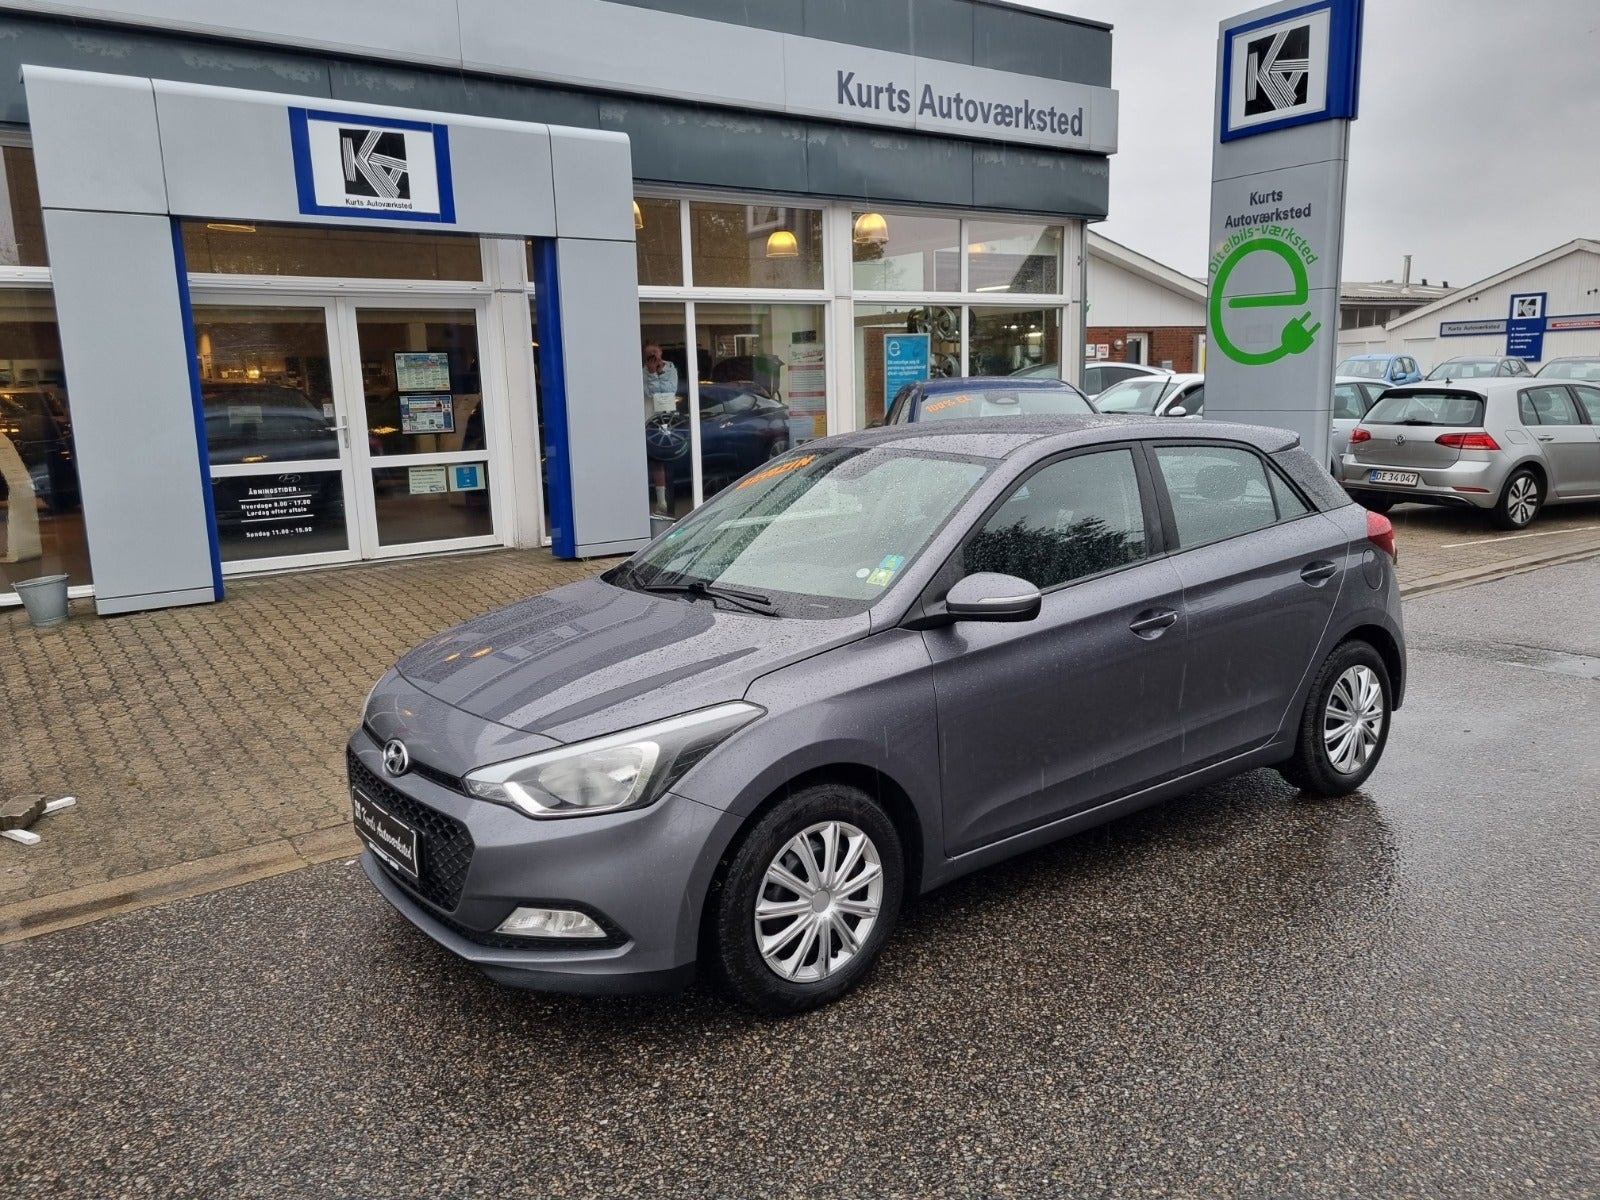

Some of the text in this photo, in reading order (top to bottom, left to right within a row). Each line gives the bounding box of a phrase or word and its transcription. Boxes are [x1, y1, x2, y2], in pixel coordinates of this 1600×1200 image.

[837, 69, 1083, 137] Kurts Autoværksted
[345, 198, 413, 209] Kurts Autoværksted
[1249, 190, 1283, 206] Kurts
[1224, 203, 1311, 228] Autoværksted
[1209, 224, 1318, 274] Dit elbils-værksted
[1376, 472, 1417, 483] DE 34 047
